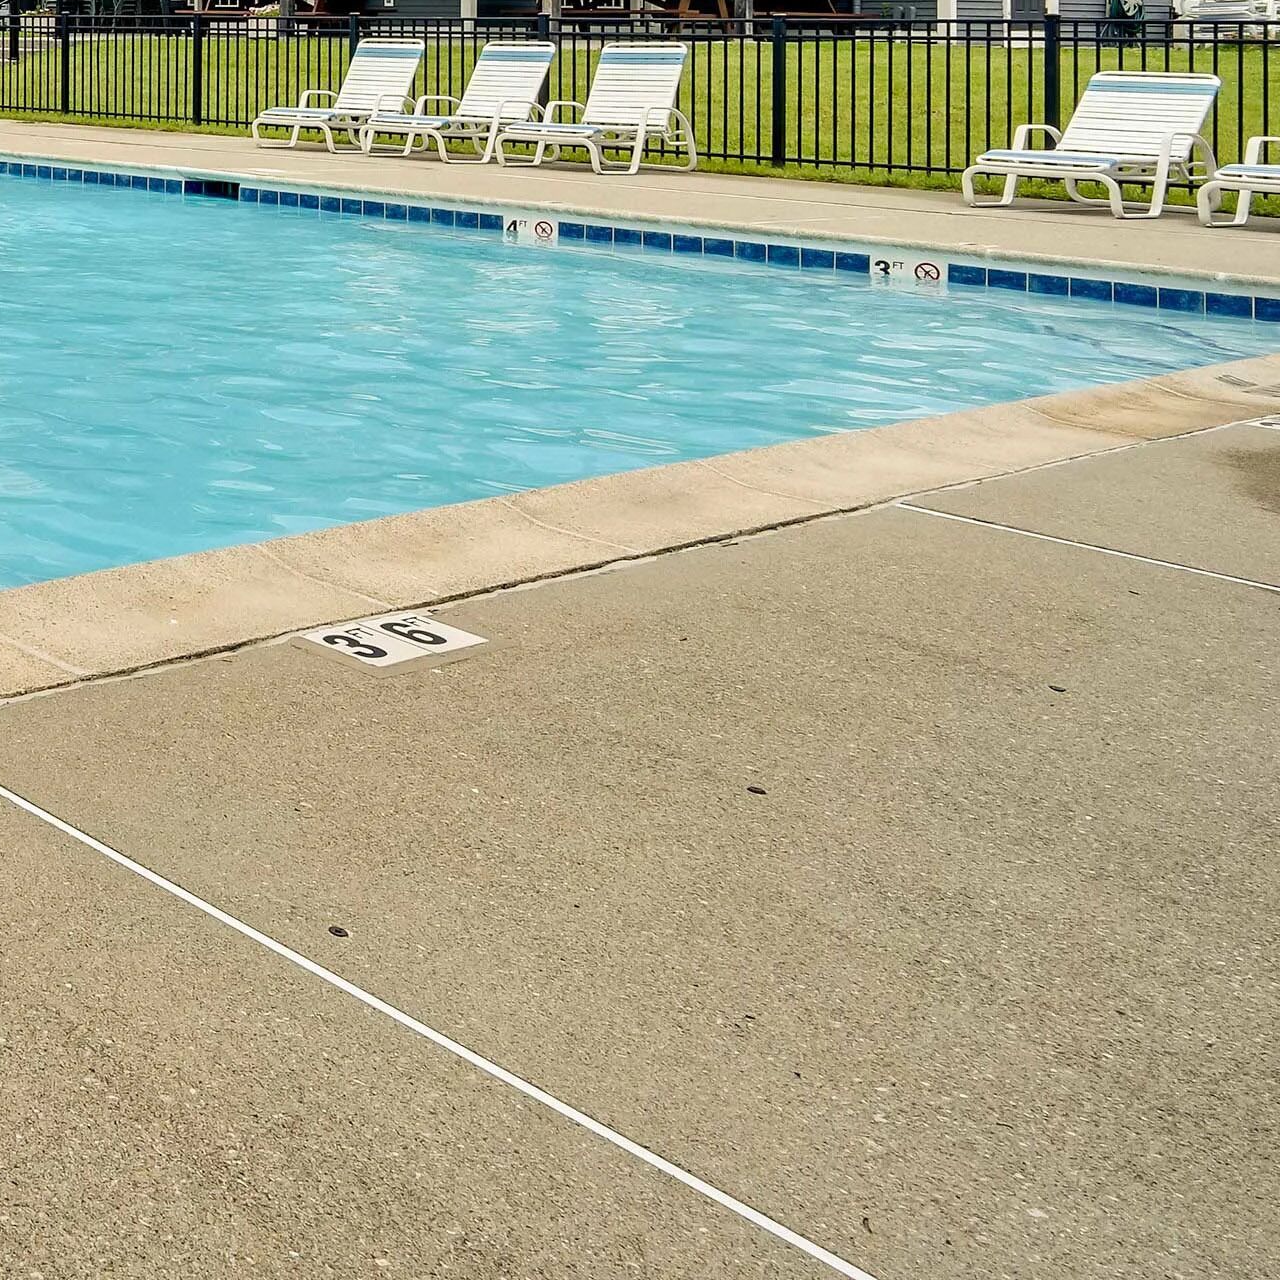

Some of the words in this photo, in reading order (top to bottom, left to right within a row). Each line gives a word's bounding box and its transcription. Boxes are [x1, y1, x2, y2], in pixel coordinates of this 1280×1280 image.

[506, 219, 518, 231] 4
[892, 261, 904, 270] FT
[343, 627, 375, 639] FT
[379, 622, 448, 645] 6
[322, 634, 388, 659] 3
